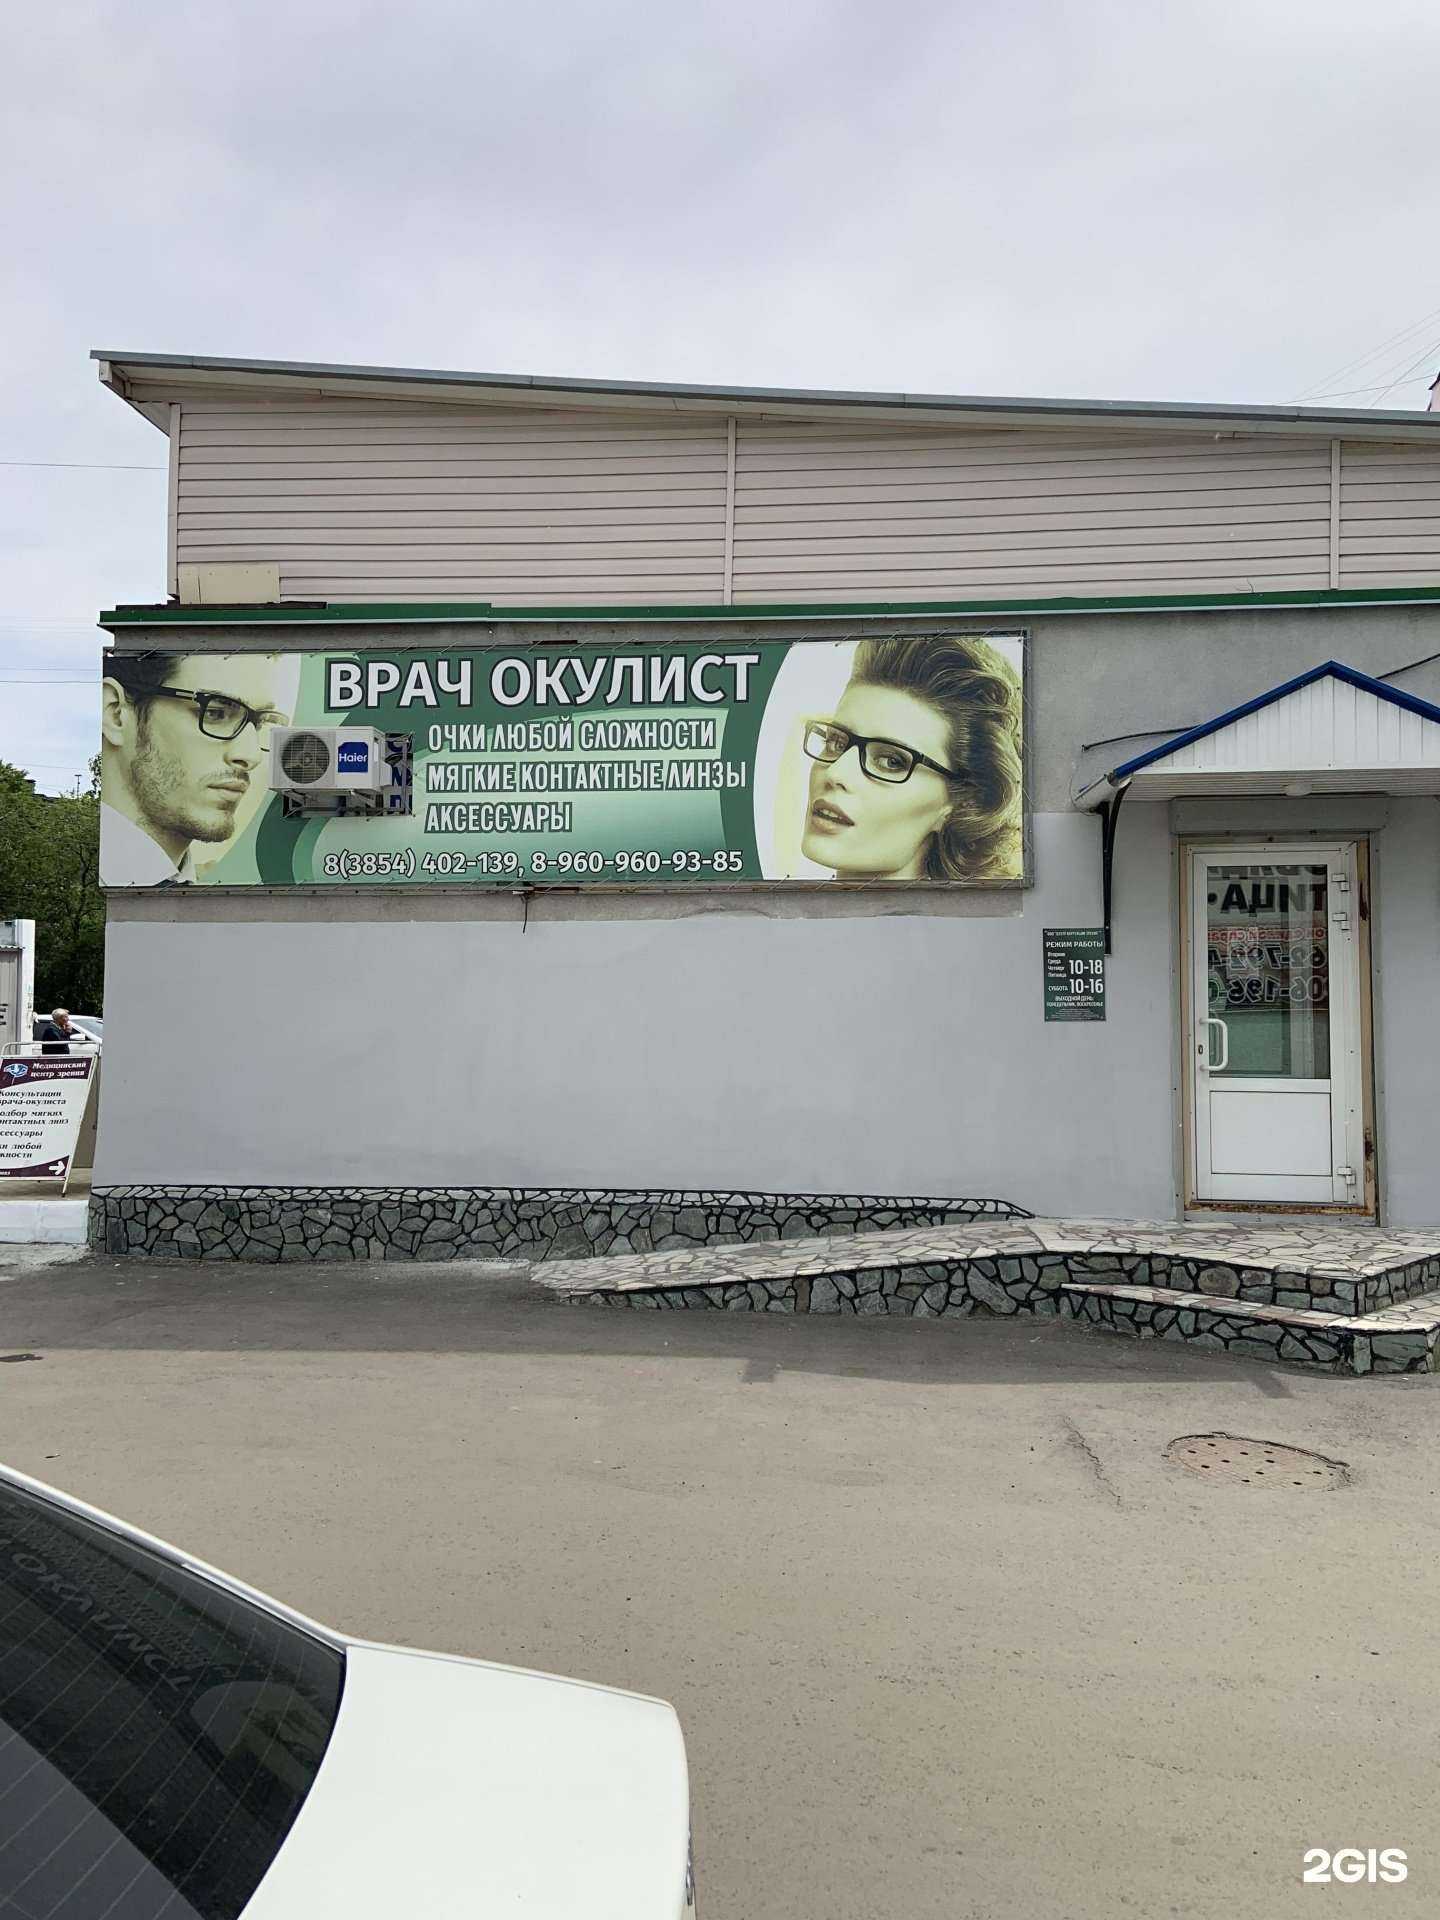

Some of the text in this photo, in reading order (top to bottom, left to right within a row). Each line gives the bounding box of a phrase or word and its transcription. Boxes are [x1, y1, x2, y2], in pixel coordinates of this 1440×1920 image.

[327, 653, 760, 710] ВРАЧ ОКУЛИСТ
[428, 716, 715, 752] ОЧКИ ЛЮБОЙ СЛОЖНОСТИ
[338, 753, 368, 762] Haier
[428, 759, 747, 792] МЯГКИЕ КОНТАКТНЫЕ ЛИНЗЫ
[425, 802, 572, 833] АКСЕССУАРЫ
[323, 849, 744, 877] 8(3854) 402-139, 8-960-960-93-85
[1069, 959, 1103, 975] 10-18
[1070, 979, 1104, 994] 10-16
[30, 1070, 85, 1079] центр зрения
[0, 1109, 28, 1118] одбор
